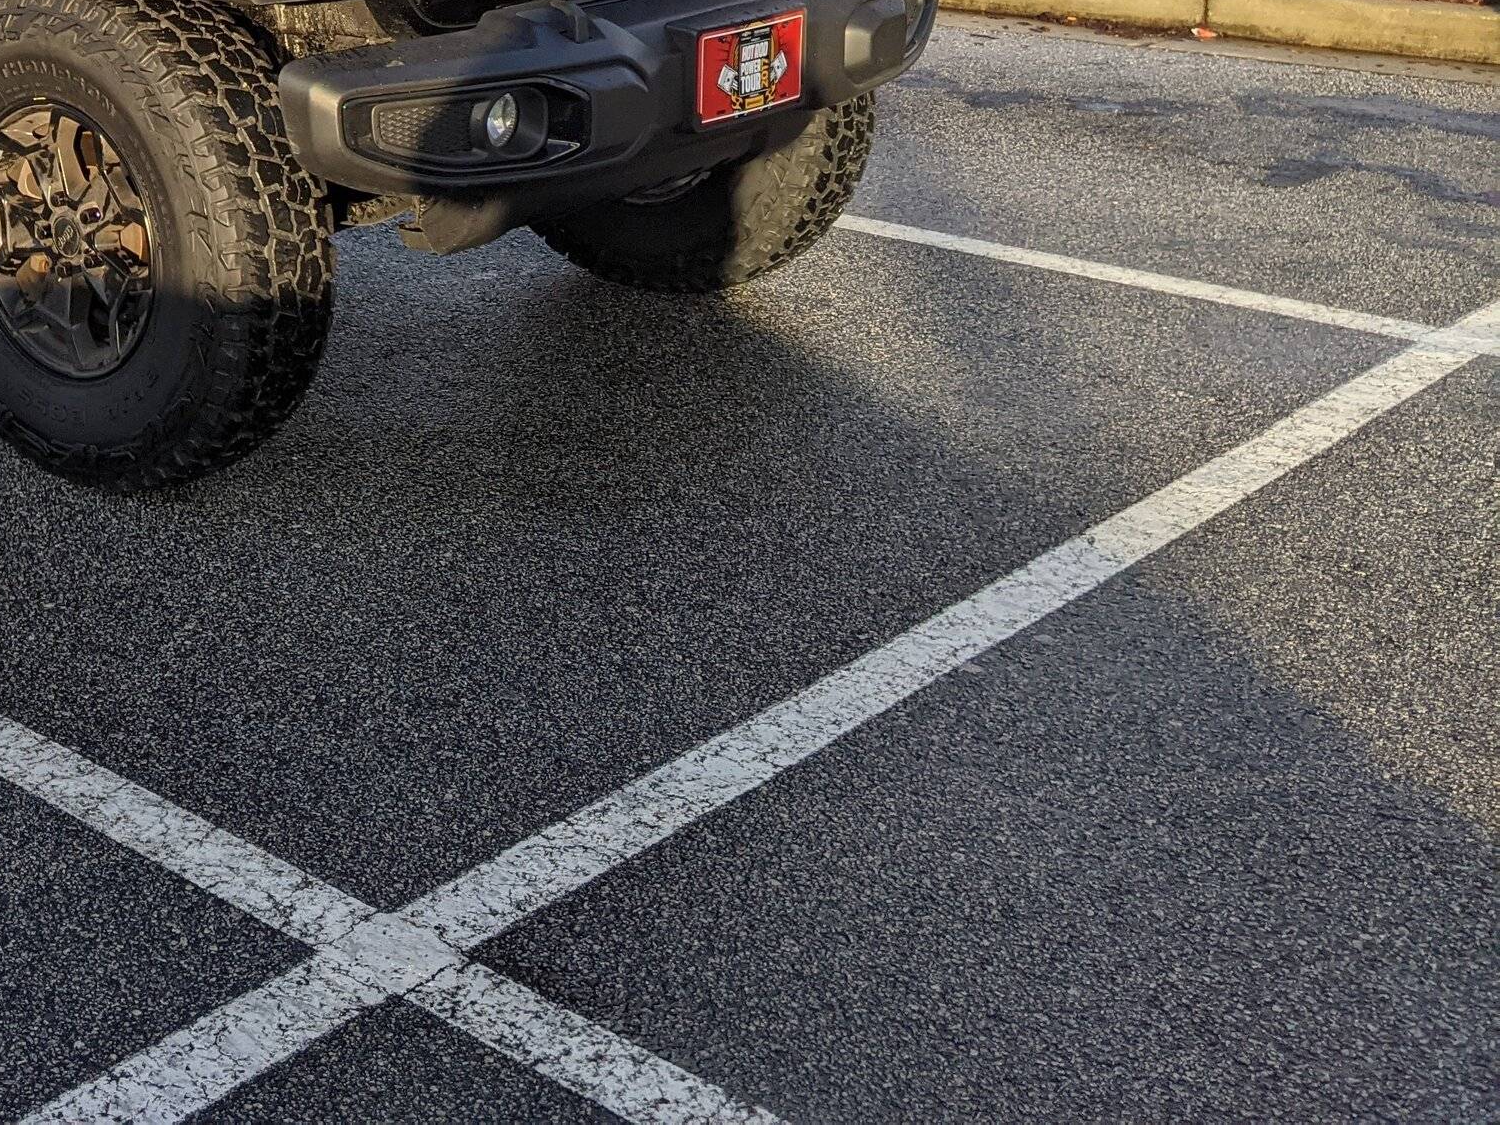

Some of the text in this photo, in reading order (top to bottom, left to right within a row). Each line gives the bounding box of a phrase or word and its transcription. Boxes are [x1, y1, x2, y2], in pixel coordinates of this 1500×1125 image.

[741, 41, 769, 62] HOT ROD
[740, 58, 761, 77] POWER
[761, 57, 769, 88] 2017
[740, 73, 761, 94] TOUR
